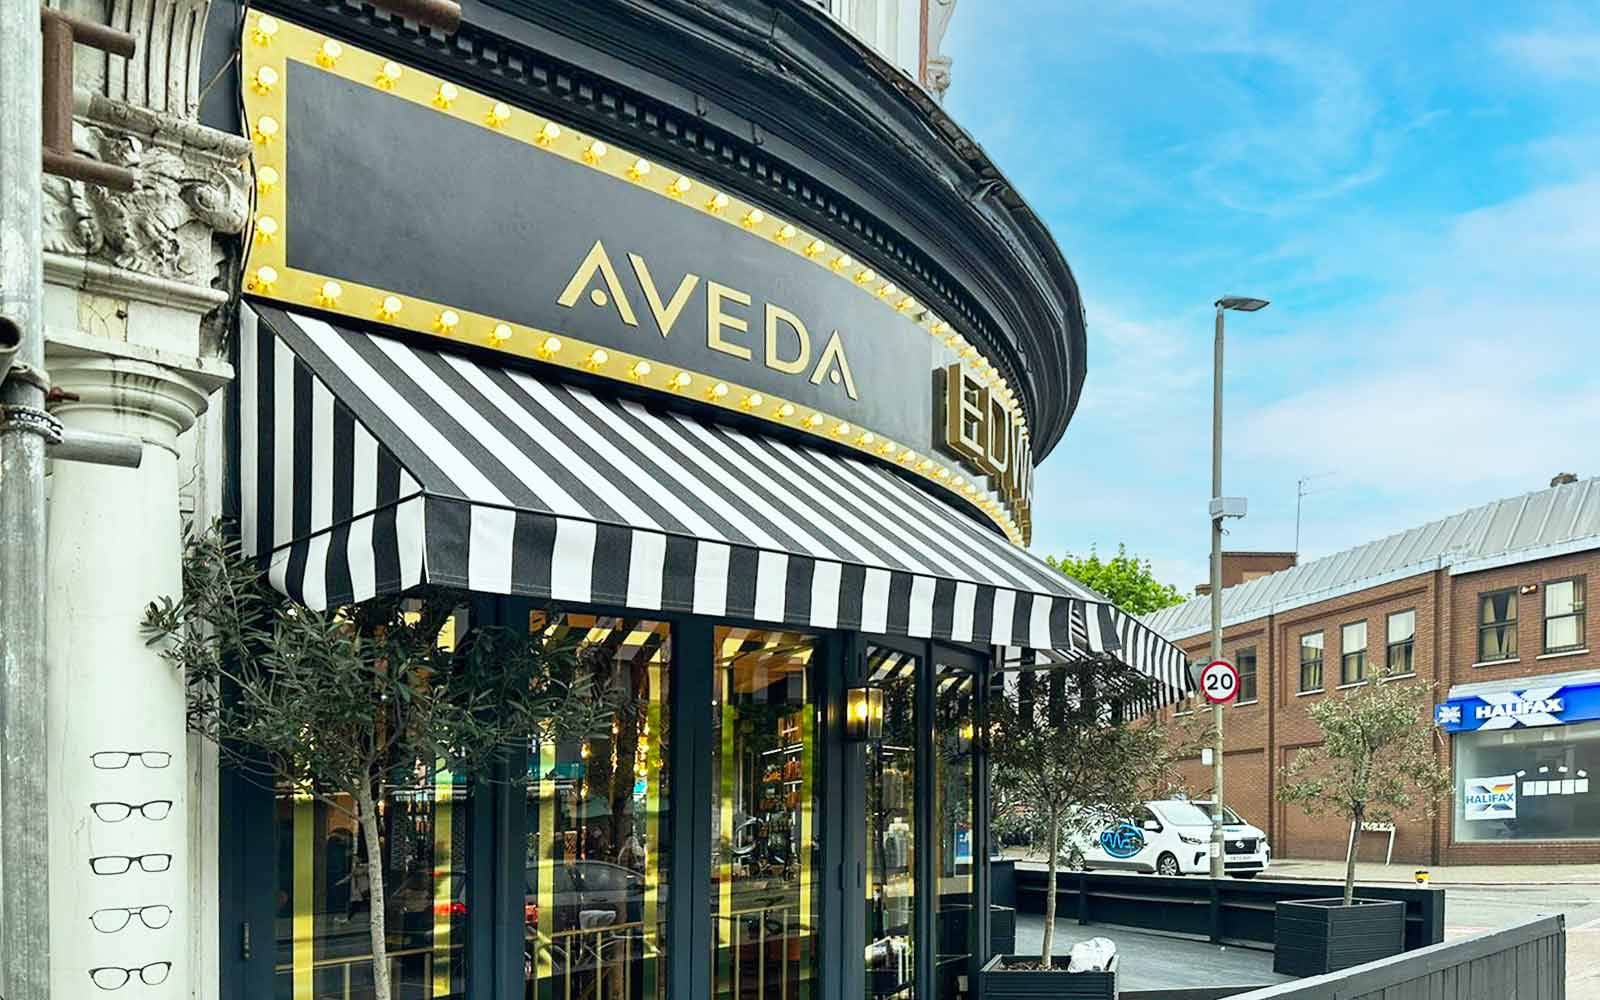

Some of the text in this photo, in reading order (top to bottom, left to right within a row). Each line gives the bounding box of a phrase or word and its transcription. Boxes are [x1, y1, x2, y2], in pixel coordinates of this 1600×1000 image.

[557, 240, 858, 400] AVEDA
[1206, 673, 1234, 690] 20
[1475, 697, 1563, 719] HALIFAX
[1465, 792, 1514, 804] HALIFAX
